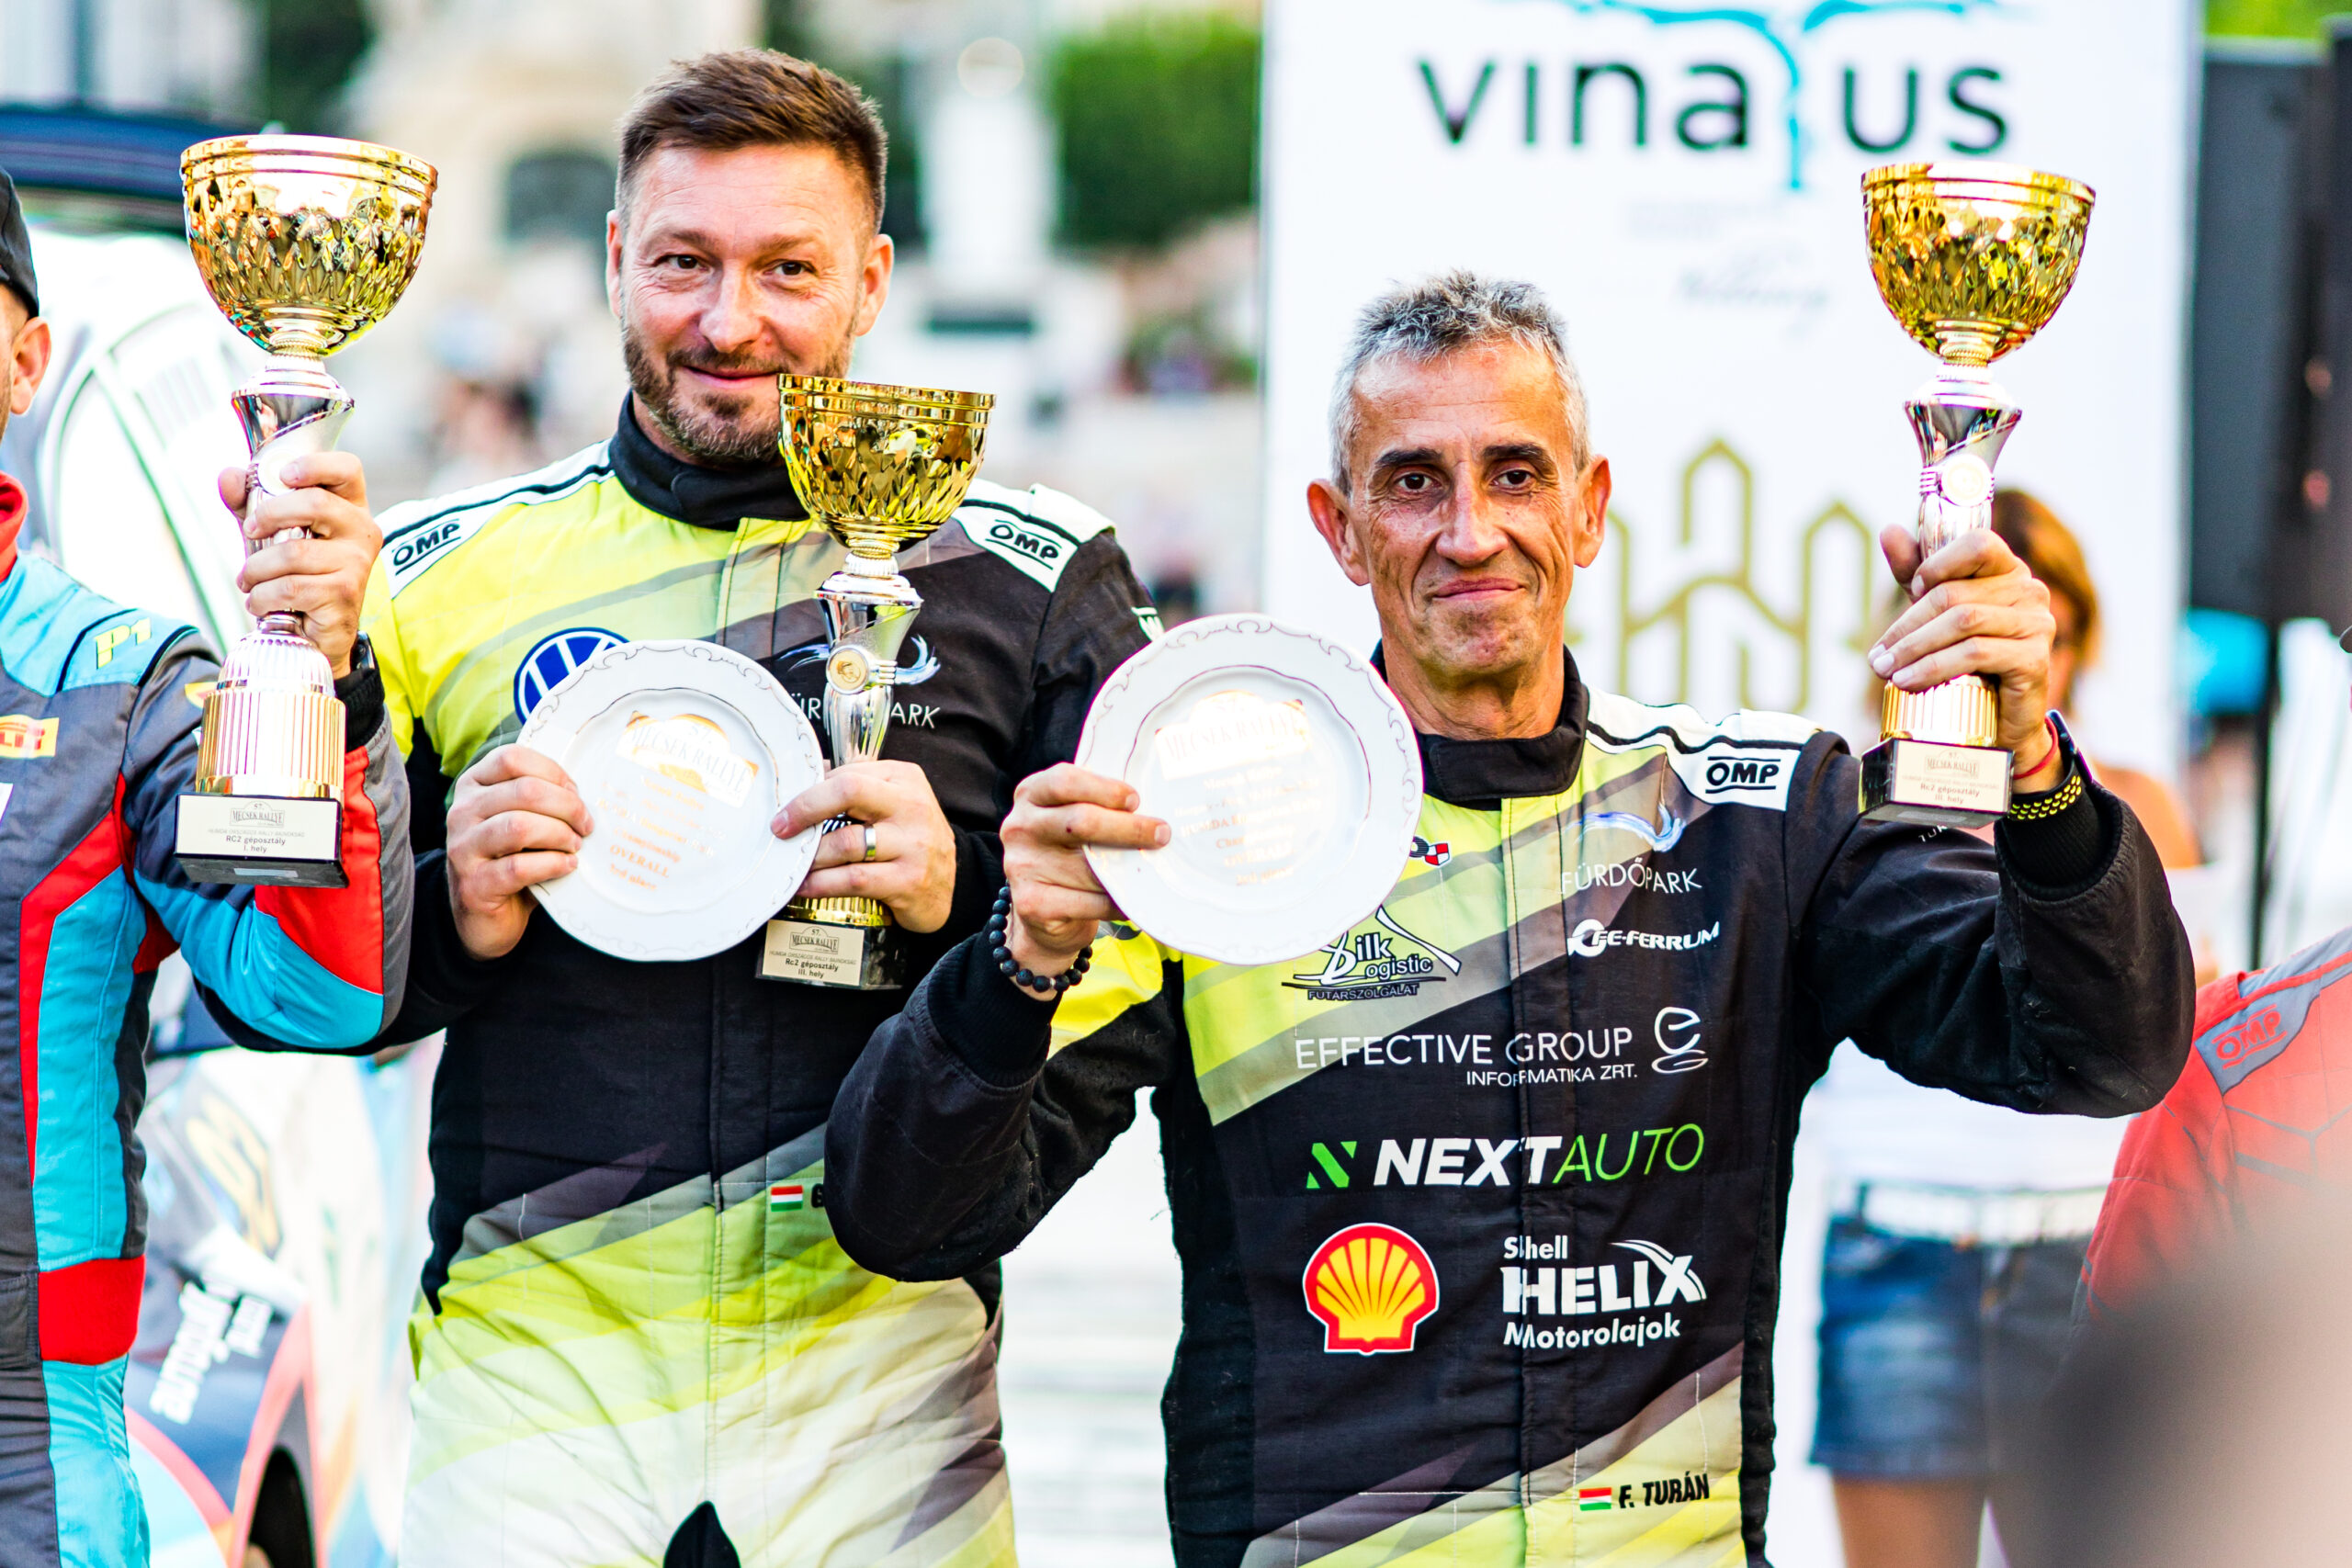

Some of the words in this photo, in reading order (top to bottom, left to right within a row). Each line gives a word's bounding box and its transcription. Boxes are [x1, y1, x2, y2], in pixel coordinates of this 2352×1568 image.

[393, 523, 460, 567] OMP
[989, 524, 1059, 559] OMP
[94, 616, 152, 670] P1
[1706, 761, 1780, 786] OMP
[226, 835, 242, 843] RC2
[243, 836, 286, 846] géposztály
[250, 845, 267, 853] hely
[609, 843, 670, 879] OVERALL
[1561, 856, 1702, 894] FÜRDŐPARK
[792, 933, 815, 946] MECSEK
[816, 936, 839, 952] RALLYE
[811, 928, 821, 936] 57.
[1590, 920, 1720, 952] FE-FERRUM
[785, 957, 799, 966] Rc2
[800, 960, 839, 972] géposztály
[808, 969, 824, 979] hely
[1295, 1034, 1493, 1069] EFFECTIVE
[1505, 1027, 1634, 1066] GROUP
[2216, 1010, 2281, 1060] OMP
[1466, 1067, 1595, 1087] INFORMATIKA
[1600, 1063, 1638, 1081] ZRT.
[1503, 1235, 1568, 1260] Shell
[1499, 1253, 1705, 1315] HELIX
[1503, 1312, 1681, 1348] Motorolajok
[1618, 1483, 1635, 1509] F.
[1642, 1470, 1710, 1506] TURÁN
